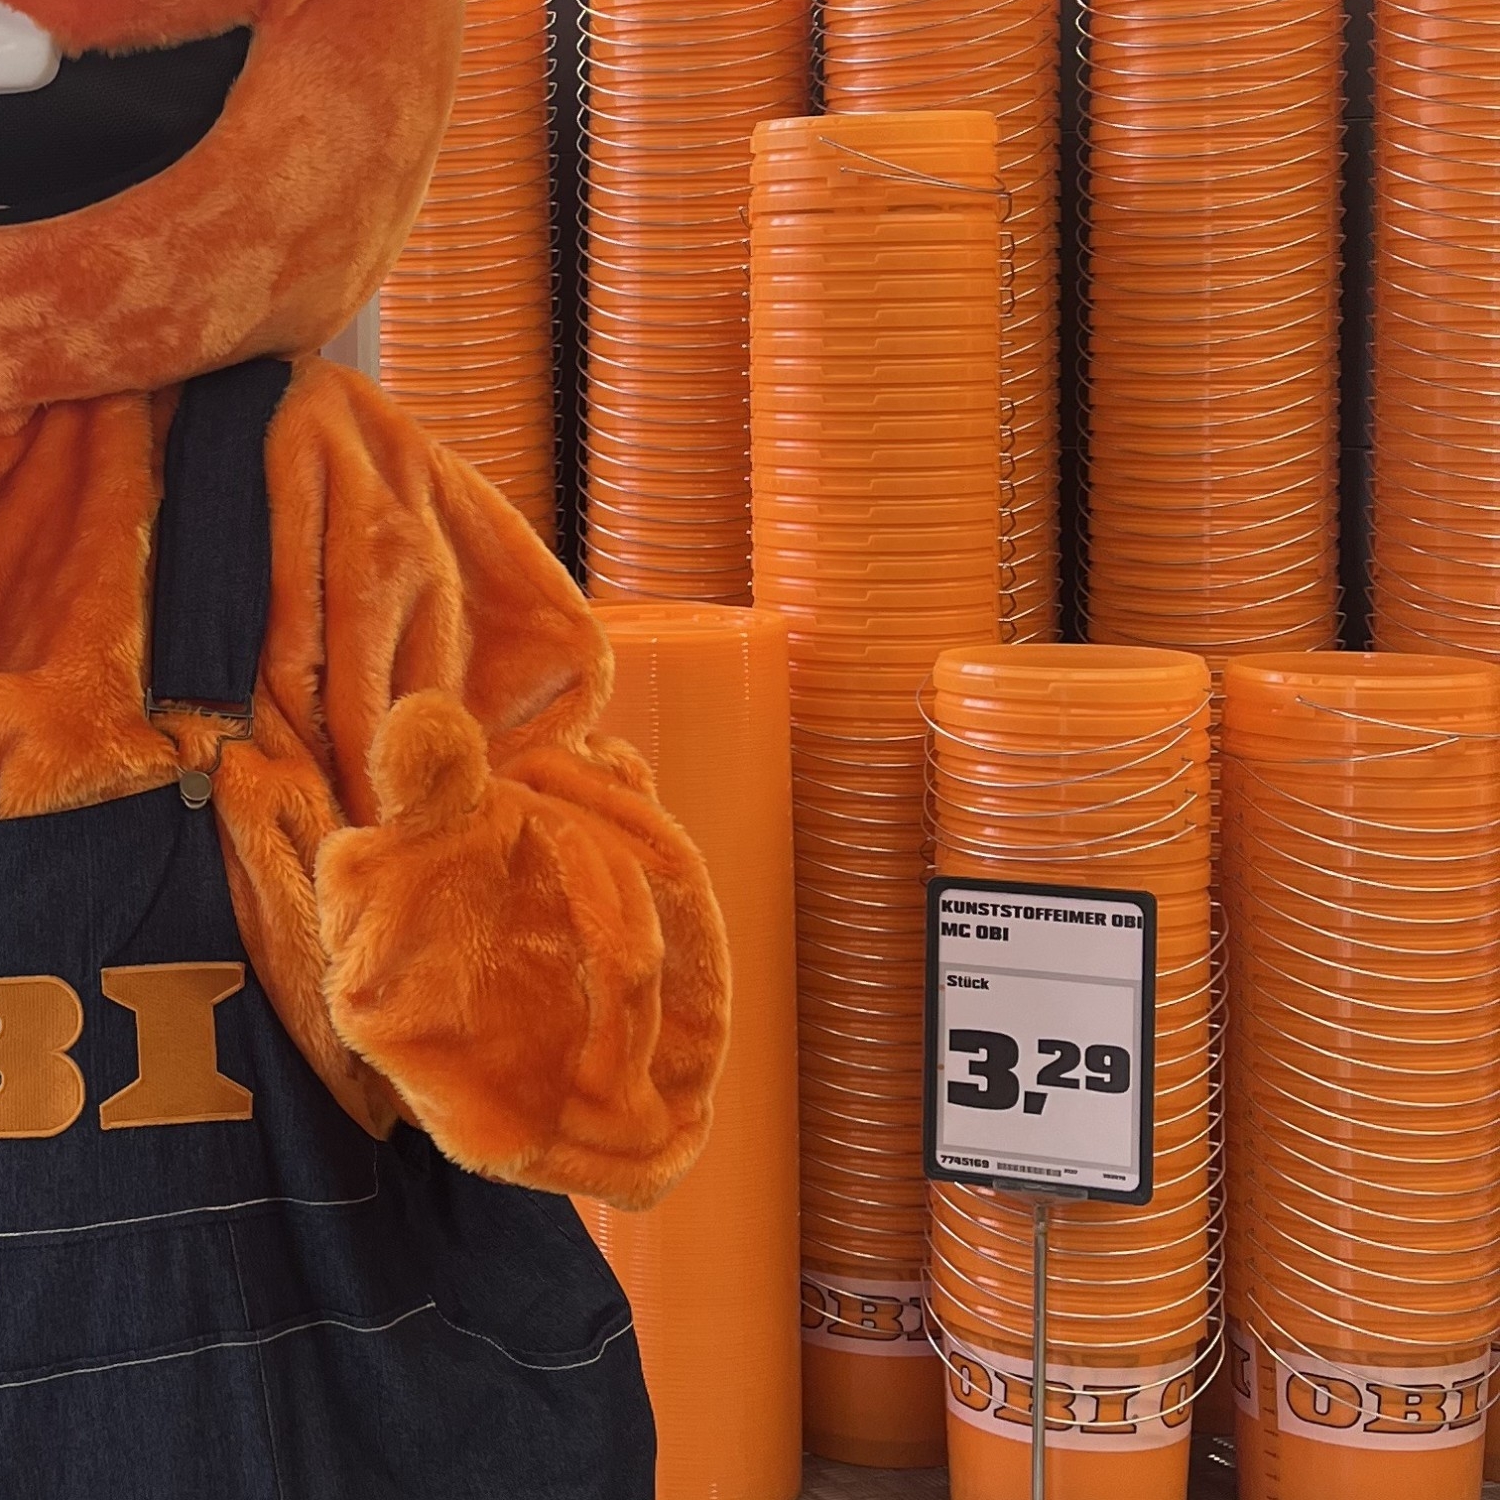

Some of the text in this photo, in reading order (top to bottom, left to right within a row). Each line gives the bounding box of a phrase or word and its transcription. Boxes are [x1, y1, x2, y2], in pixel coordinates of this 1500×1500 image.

[940, 899, 1143, 930] KUNSTSTOFFEIMER OBI
[940, 921, 1010, 942] MC OBI
[946, 974, 990, 991] Stück
[947, 1028, 1131, 1116] 3,29
[948, 1350, 1142, 1435] OBI
[1285, 1371, 1487, 1435] OBI
